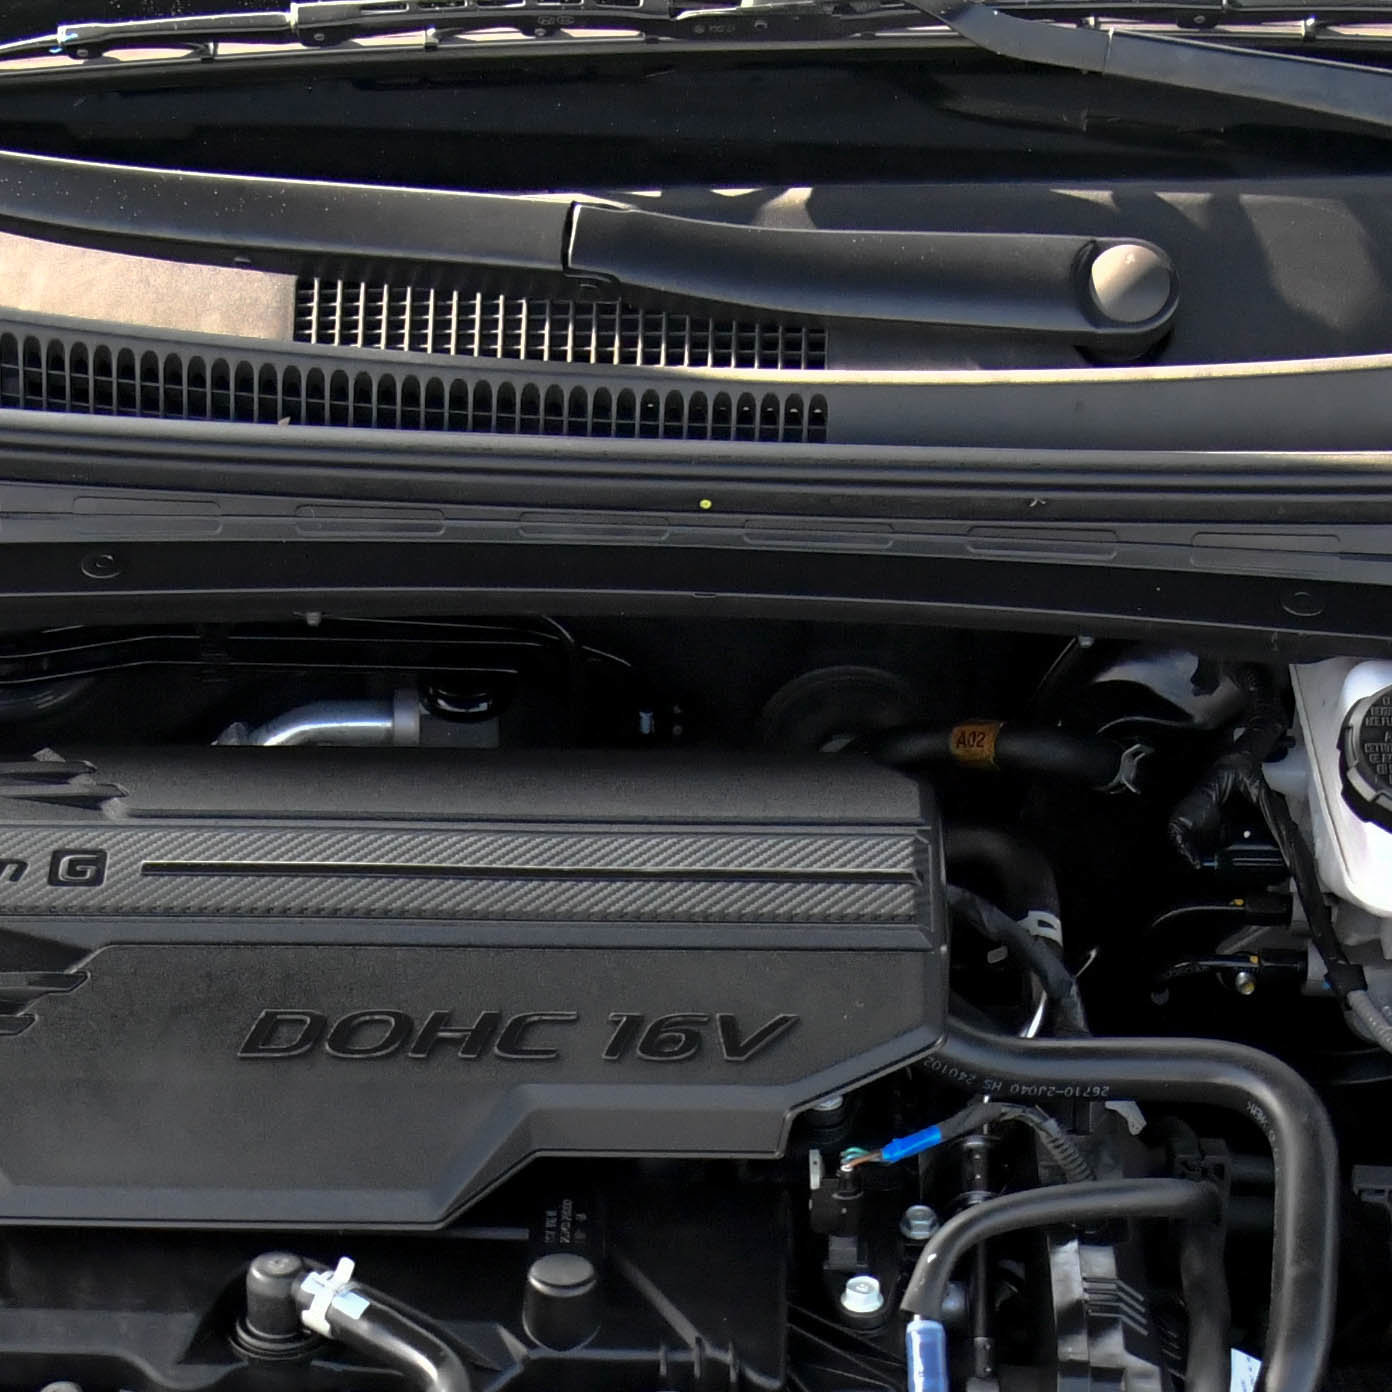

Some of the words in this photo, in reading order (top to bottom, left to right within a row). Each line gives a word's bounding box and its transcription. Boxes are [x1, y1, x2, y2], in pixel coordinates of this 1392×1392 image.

[955, 730, 987, 749] A02
[238, 1007, 578, 1061] DOHC
[602, 1009, 800, 1063] 16V
